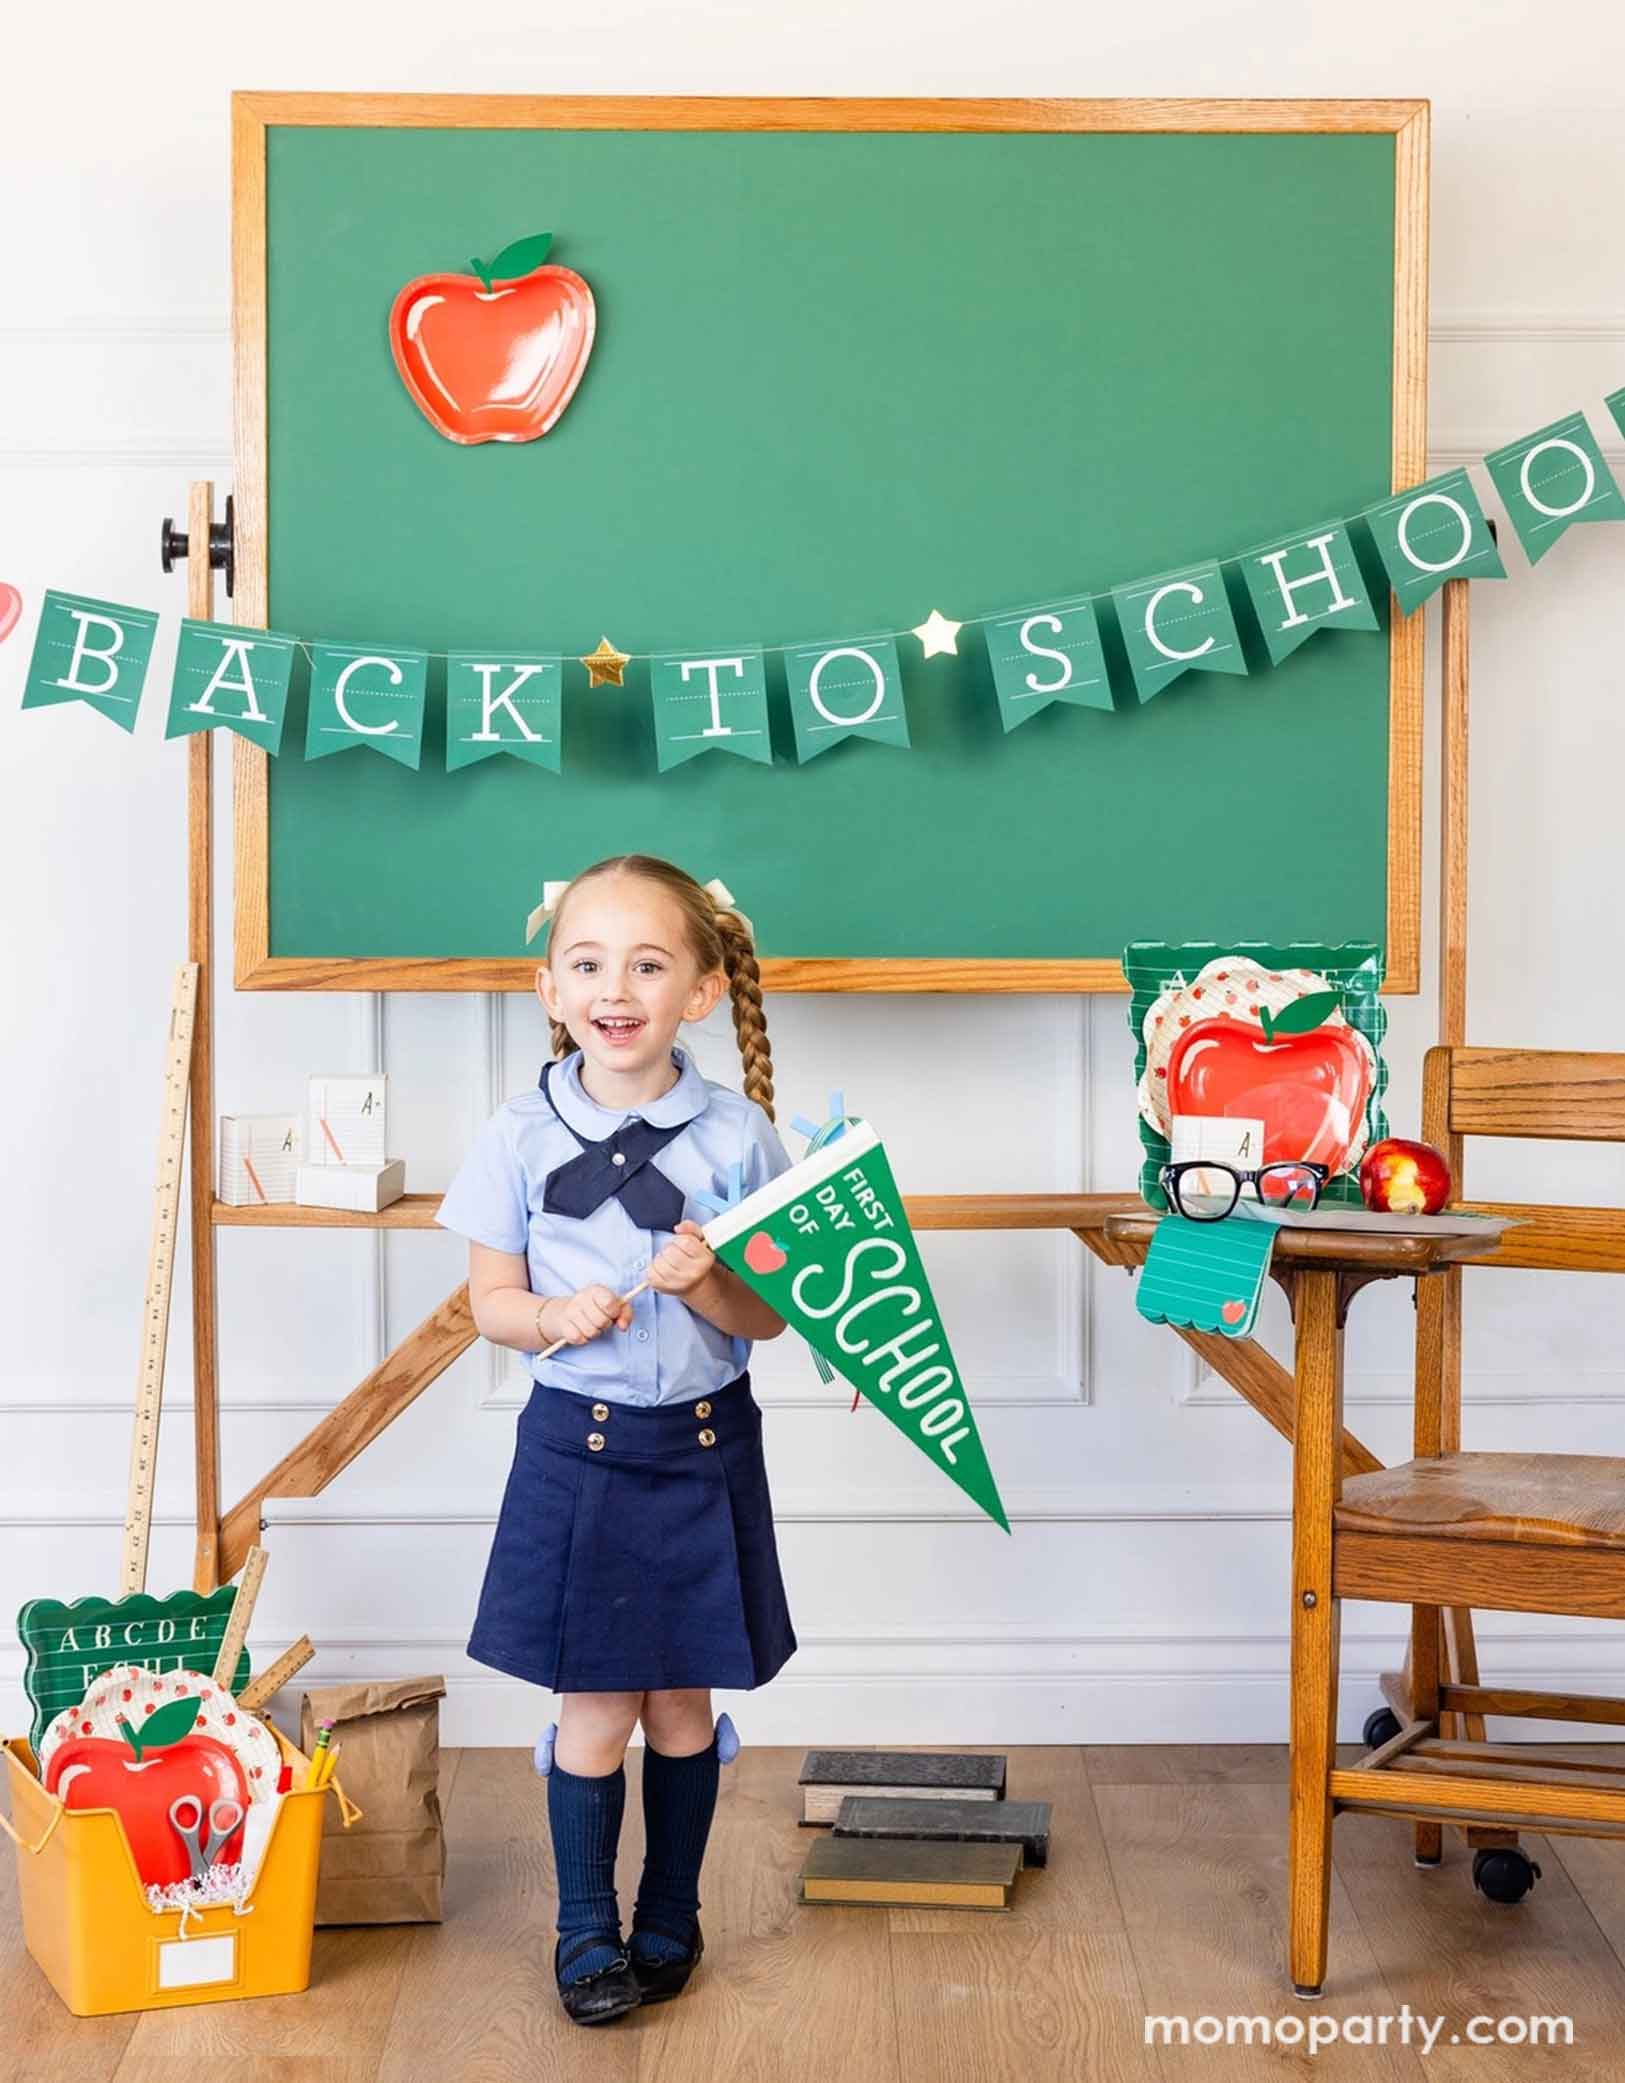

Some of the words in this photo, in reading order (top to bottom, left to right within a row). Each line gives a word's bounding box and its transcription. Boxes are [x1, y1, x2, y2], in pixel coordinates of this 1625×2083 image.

[56, 609, 543, 742] BACK
[681, 647, 885, 737] TO
[789, 1204, 820, 1235] OF
[816, 1185, 856, 1231] DAY
[843, 1167, 895, 1231] FIRST
[792, 1237, 970, 1465] SCHOOL
